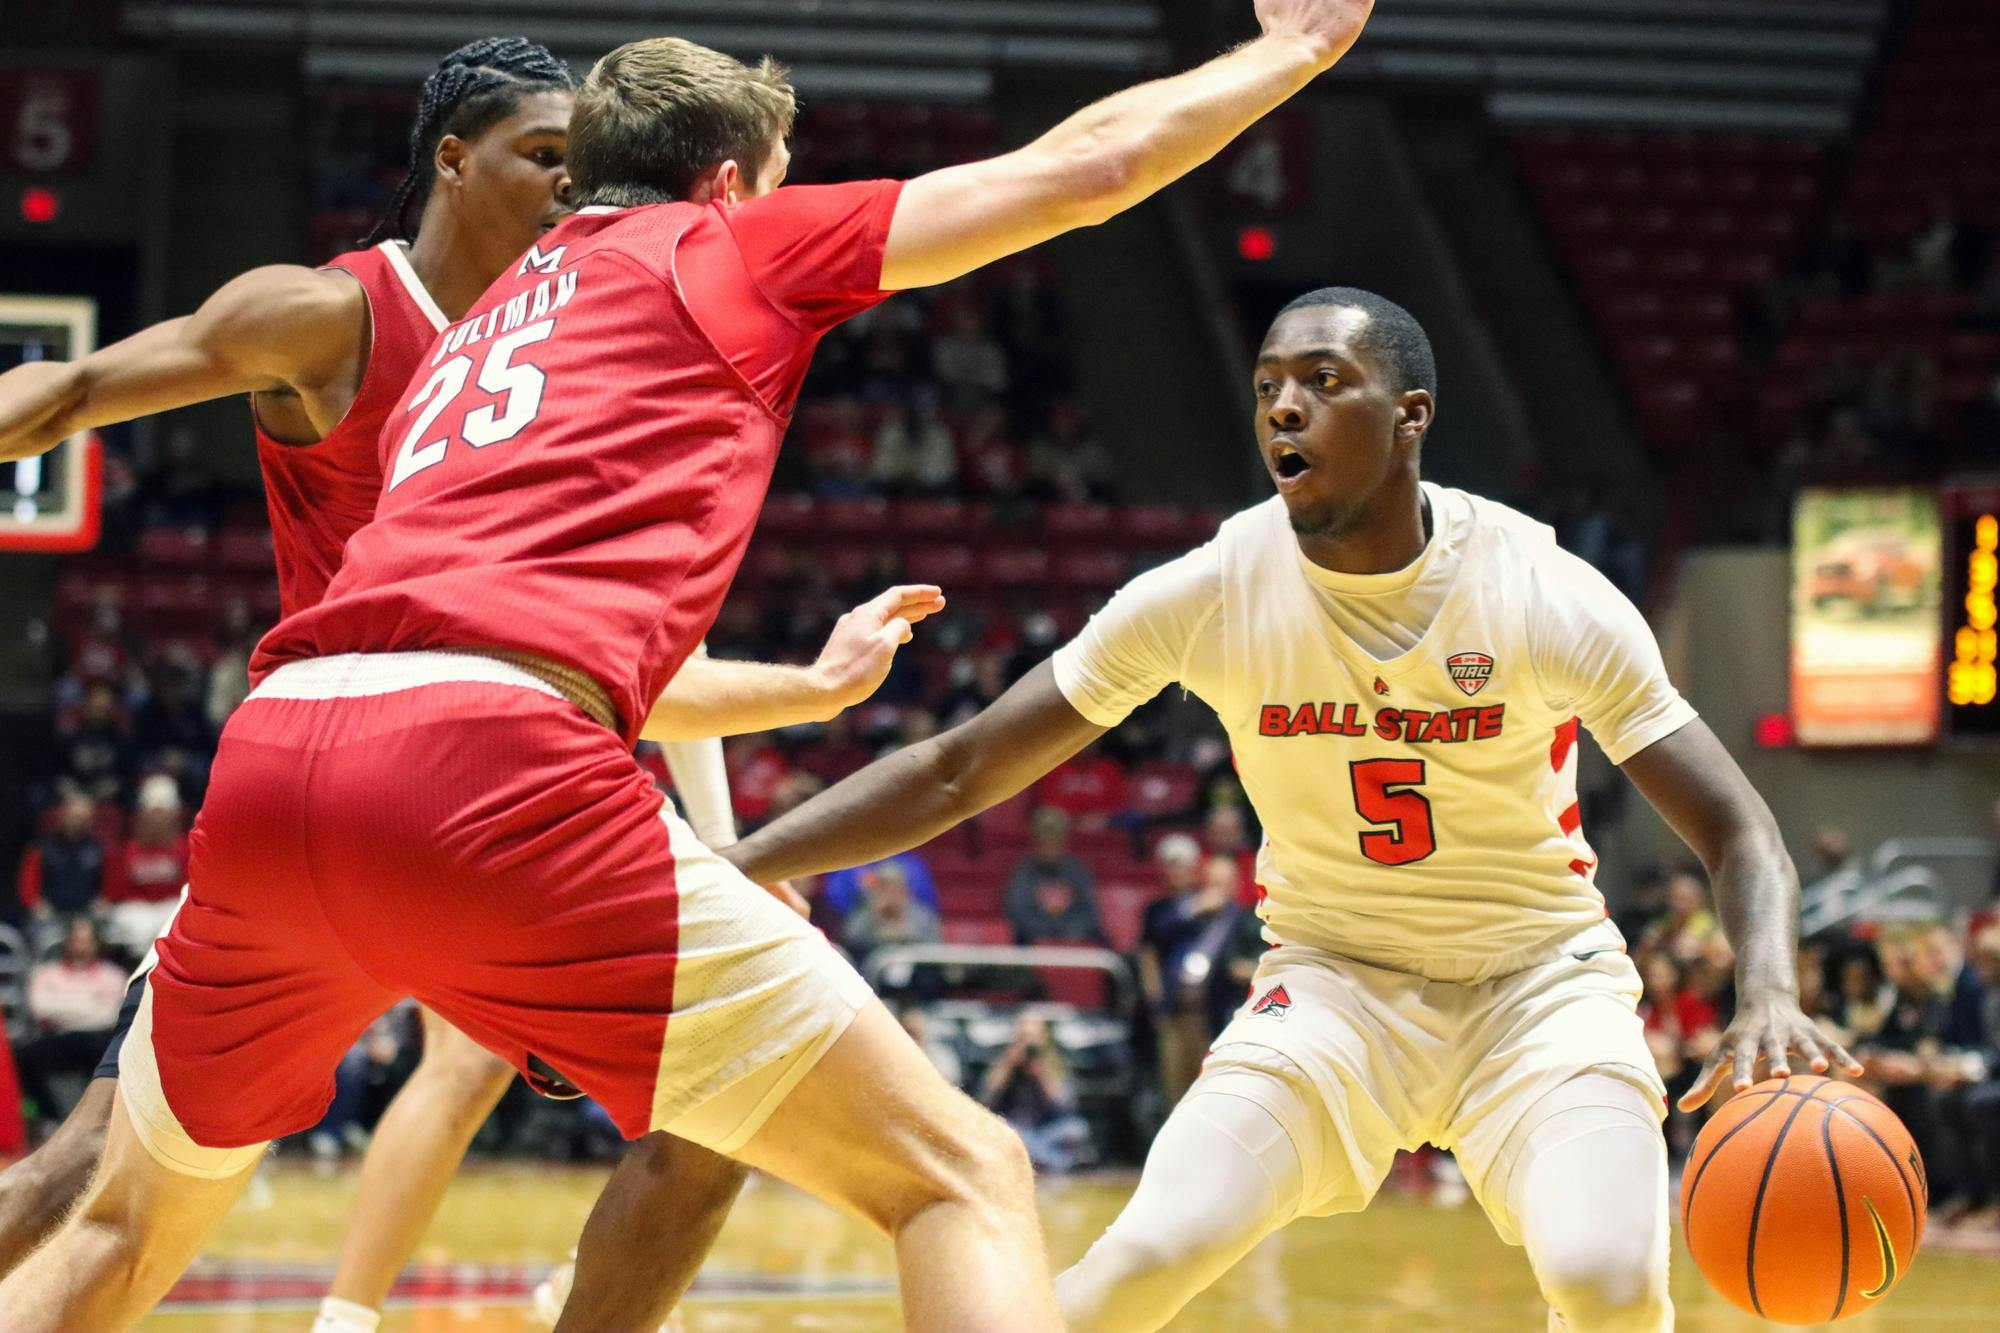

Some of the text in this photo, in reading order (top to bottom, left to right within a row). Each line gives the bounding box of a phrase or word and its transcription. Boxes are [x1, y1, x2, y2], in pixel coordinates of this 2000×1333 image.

[516, 243, 568, 279] M
[387, 317, 557, 494] 25
[1450, 665, 1492, 679] MAC
[1258, 702, 1506, 743] BALL STATE
[1348, 757, 1437, 866] 5
